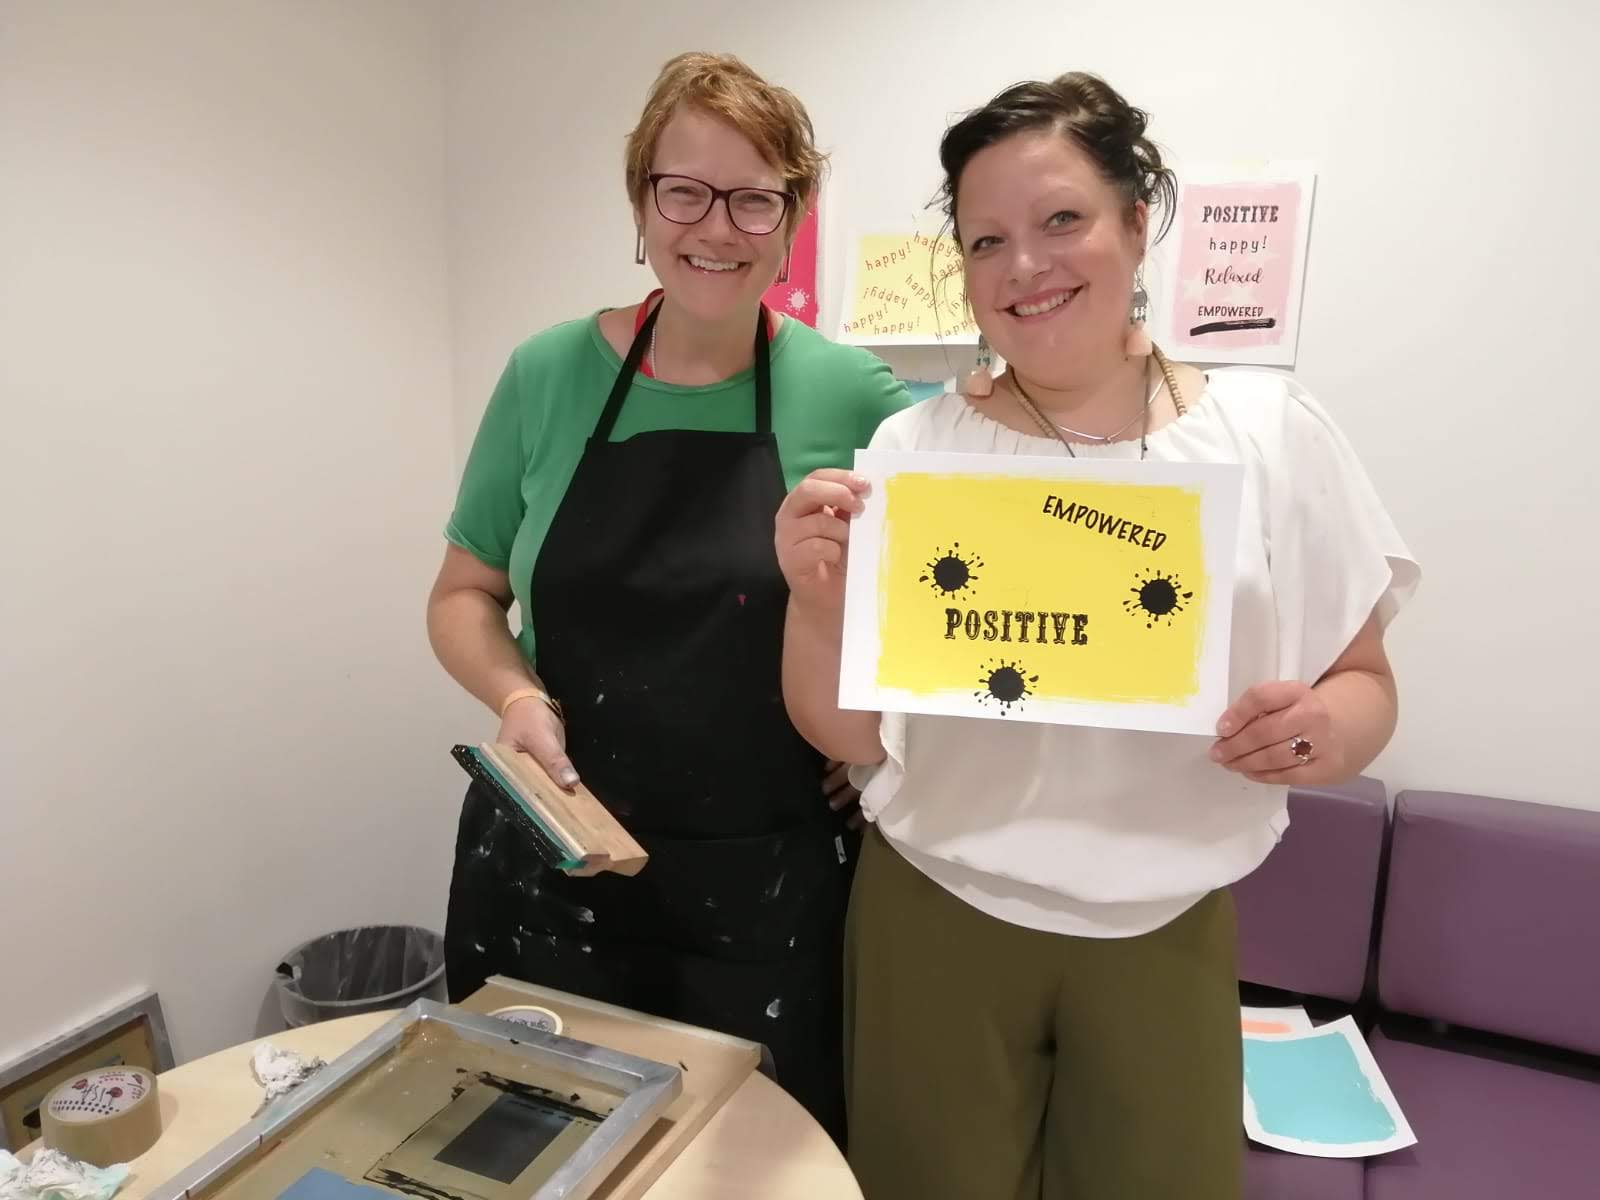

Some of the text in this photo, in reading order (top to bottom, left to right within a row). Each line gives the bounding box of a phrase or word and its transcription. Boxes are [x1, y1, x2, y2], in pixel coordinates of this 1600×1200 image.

[1202, 205, 1279, 223] POSITIVE
[1209, 235, 1267, 254] happy!
[865, 241, 911, 271] happy!
[1205, 265, 1263, 286] Relaxed
[863, 286, 909, 309] happy!
[843, 303, 889, 333] happy!
[1197, 305, 1264, 317] EMPOWERED
[874, 316, 920, 335] happy!
[1042, 495, 1167, 552] EMPOWERED
[944, 608, 1089, 645] POSITIVE
